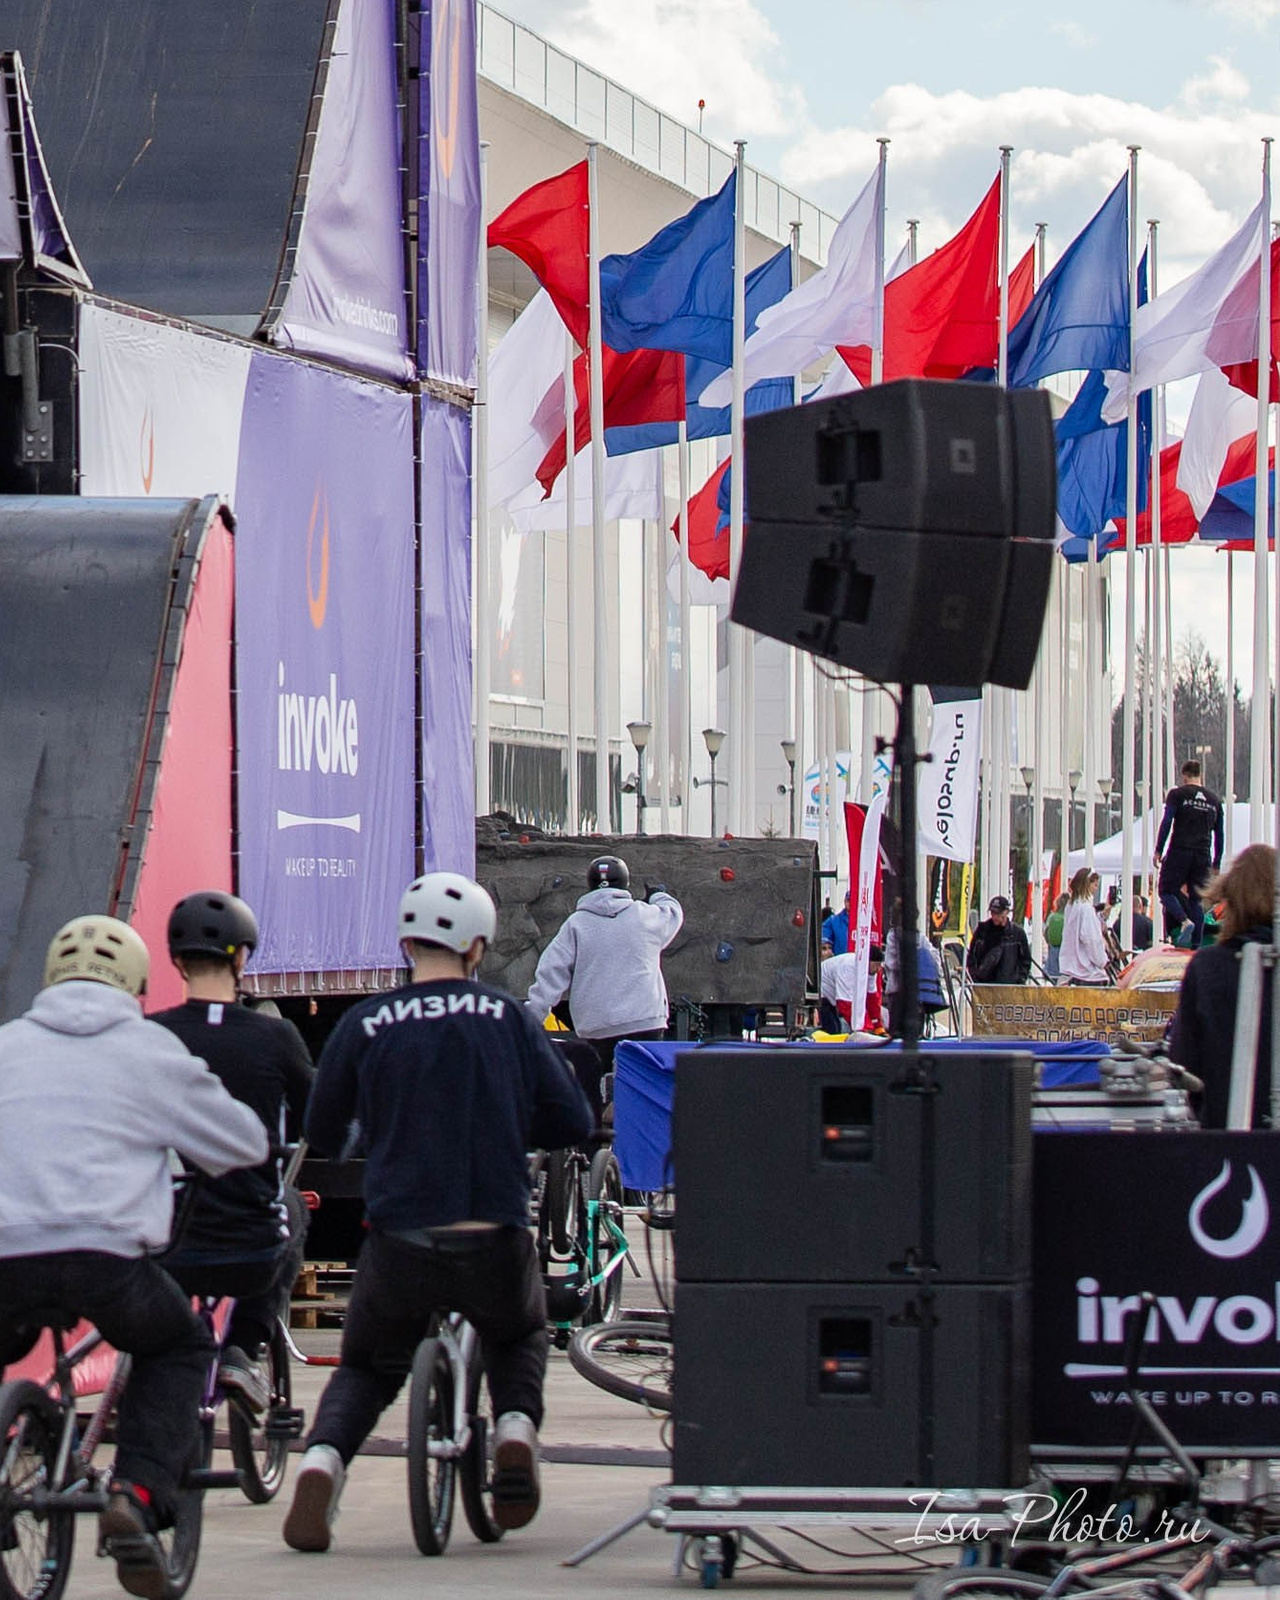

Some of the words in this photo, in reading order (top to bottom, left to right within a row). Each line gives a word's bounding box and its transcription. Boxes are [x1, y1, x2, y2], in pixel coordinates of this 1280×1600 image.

[278, 660, 359, 778] invoke
[361, 993, 505, 1038] МИЗИН
[1095, 1007, 1176, 1026] АДРЕНА
[1076, 1276, 1280, 1344] invo
[1175, 1391, 1211, 1405] UP
[1218, 1391, 1255, 1406] TO
